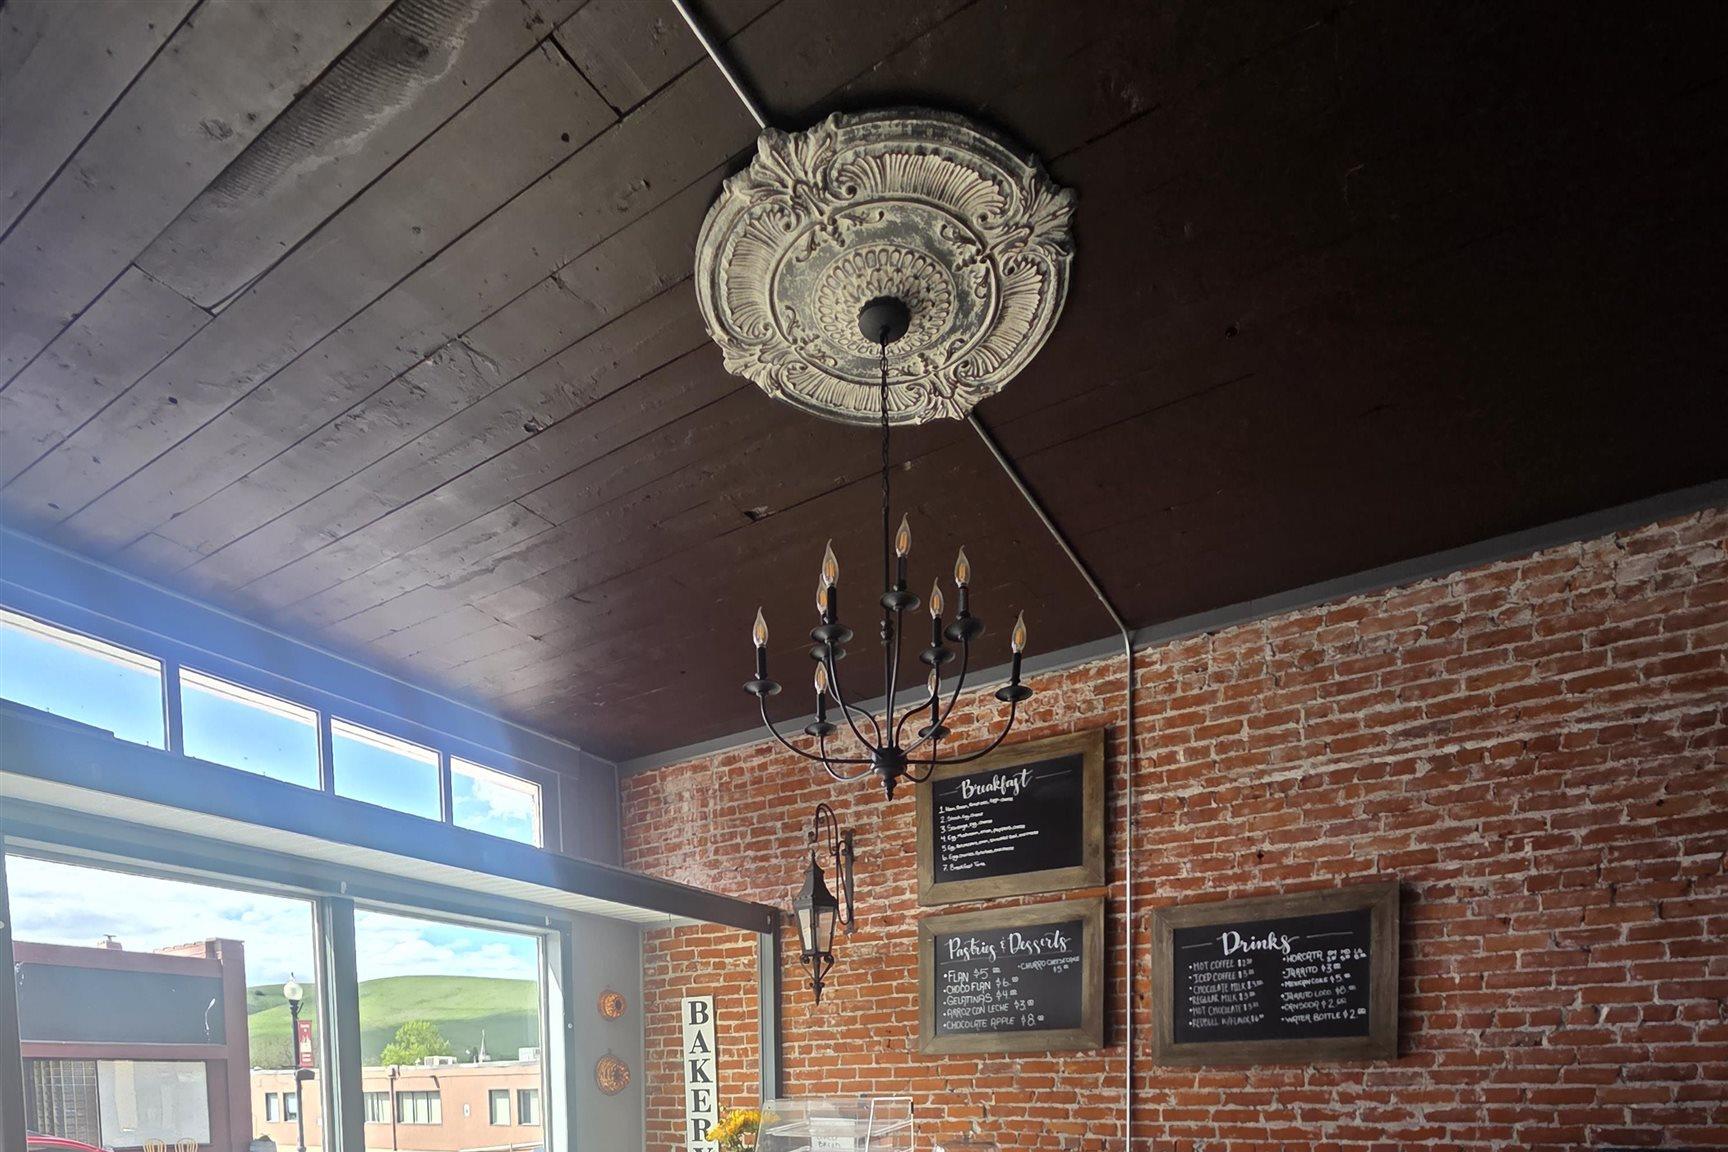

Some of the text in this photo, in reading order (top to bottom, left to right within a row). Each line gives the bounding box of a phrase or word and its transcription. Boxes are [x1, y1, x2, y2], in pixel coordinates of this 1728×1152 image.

[957, 769, 1033, 800] Breakfast
[944, 937, 997, 963] Pastries
[1007, 930, 1072, 956] Desserts
[1217, 930, 1300, 956] Drinks
[947, 970, 969, 984] FLAN
[971, 981, 991, 994] FLAN
